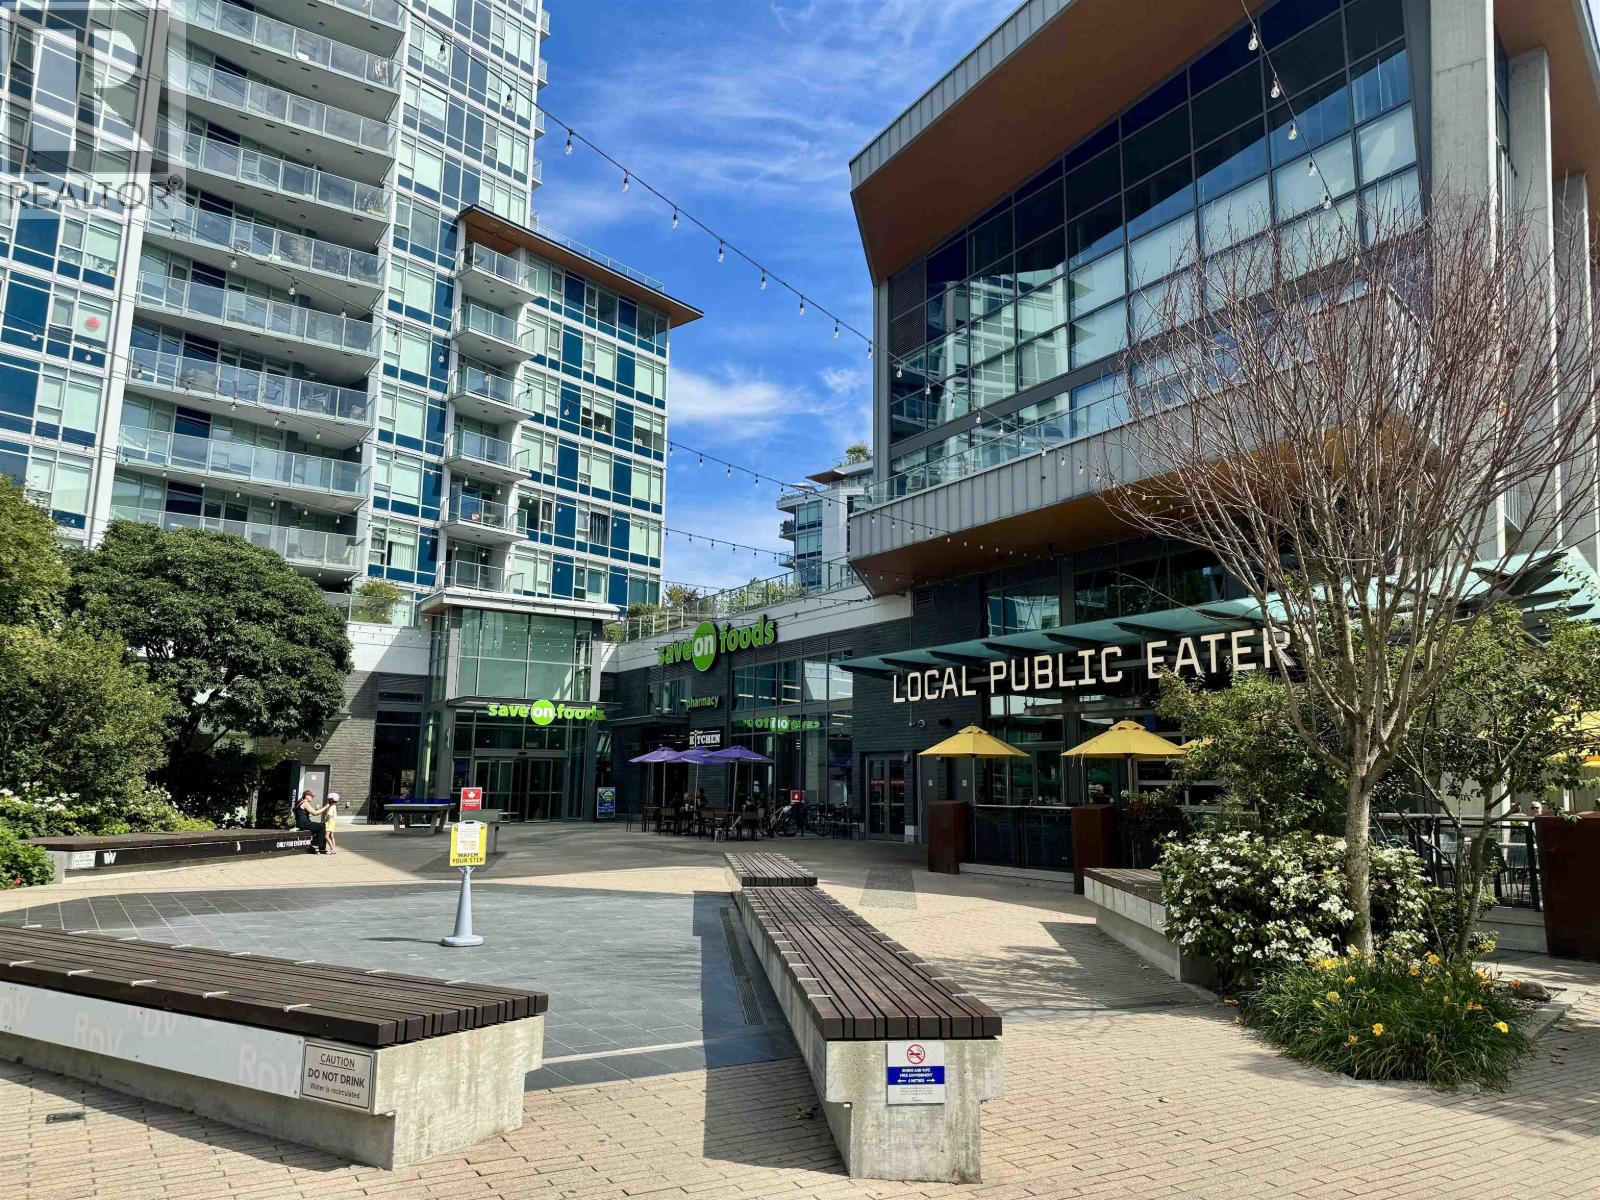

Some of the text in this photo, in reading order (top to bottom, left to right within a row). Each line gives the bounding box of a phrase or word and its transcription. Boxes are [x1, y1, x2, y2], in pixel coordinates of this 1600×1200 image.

[657, 614, 777, 666] save on foods
[893, 622, 1313, 703] LOCAL PUBLIC EATER
[686, 695, 720, 711] pharmacy
[487, 703, 606, 721] save on foods
[688, 732, 721, 747] KITCHEN
[469, 856, 484, 864] STEP
[320, 1053, 356, 1069] CAUTION
[308, 1068, 366, 1089] DO NOT DRINK
[310, 1082, 325, 1092] Water
[331, 1087, 361, 1099] recirculated
